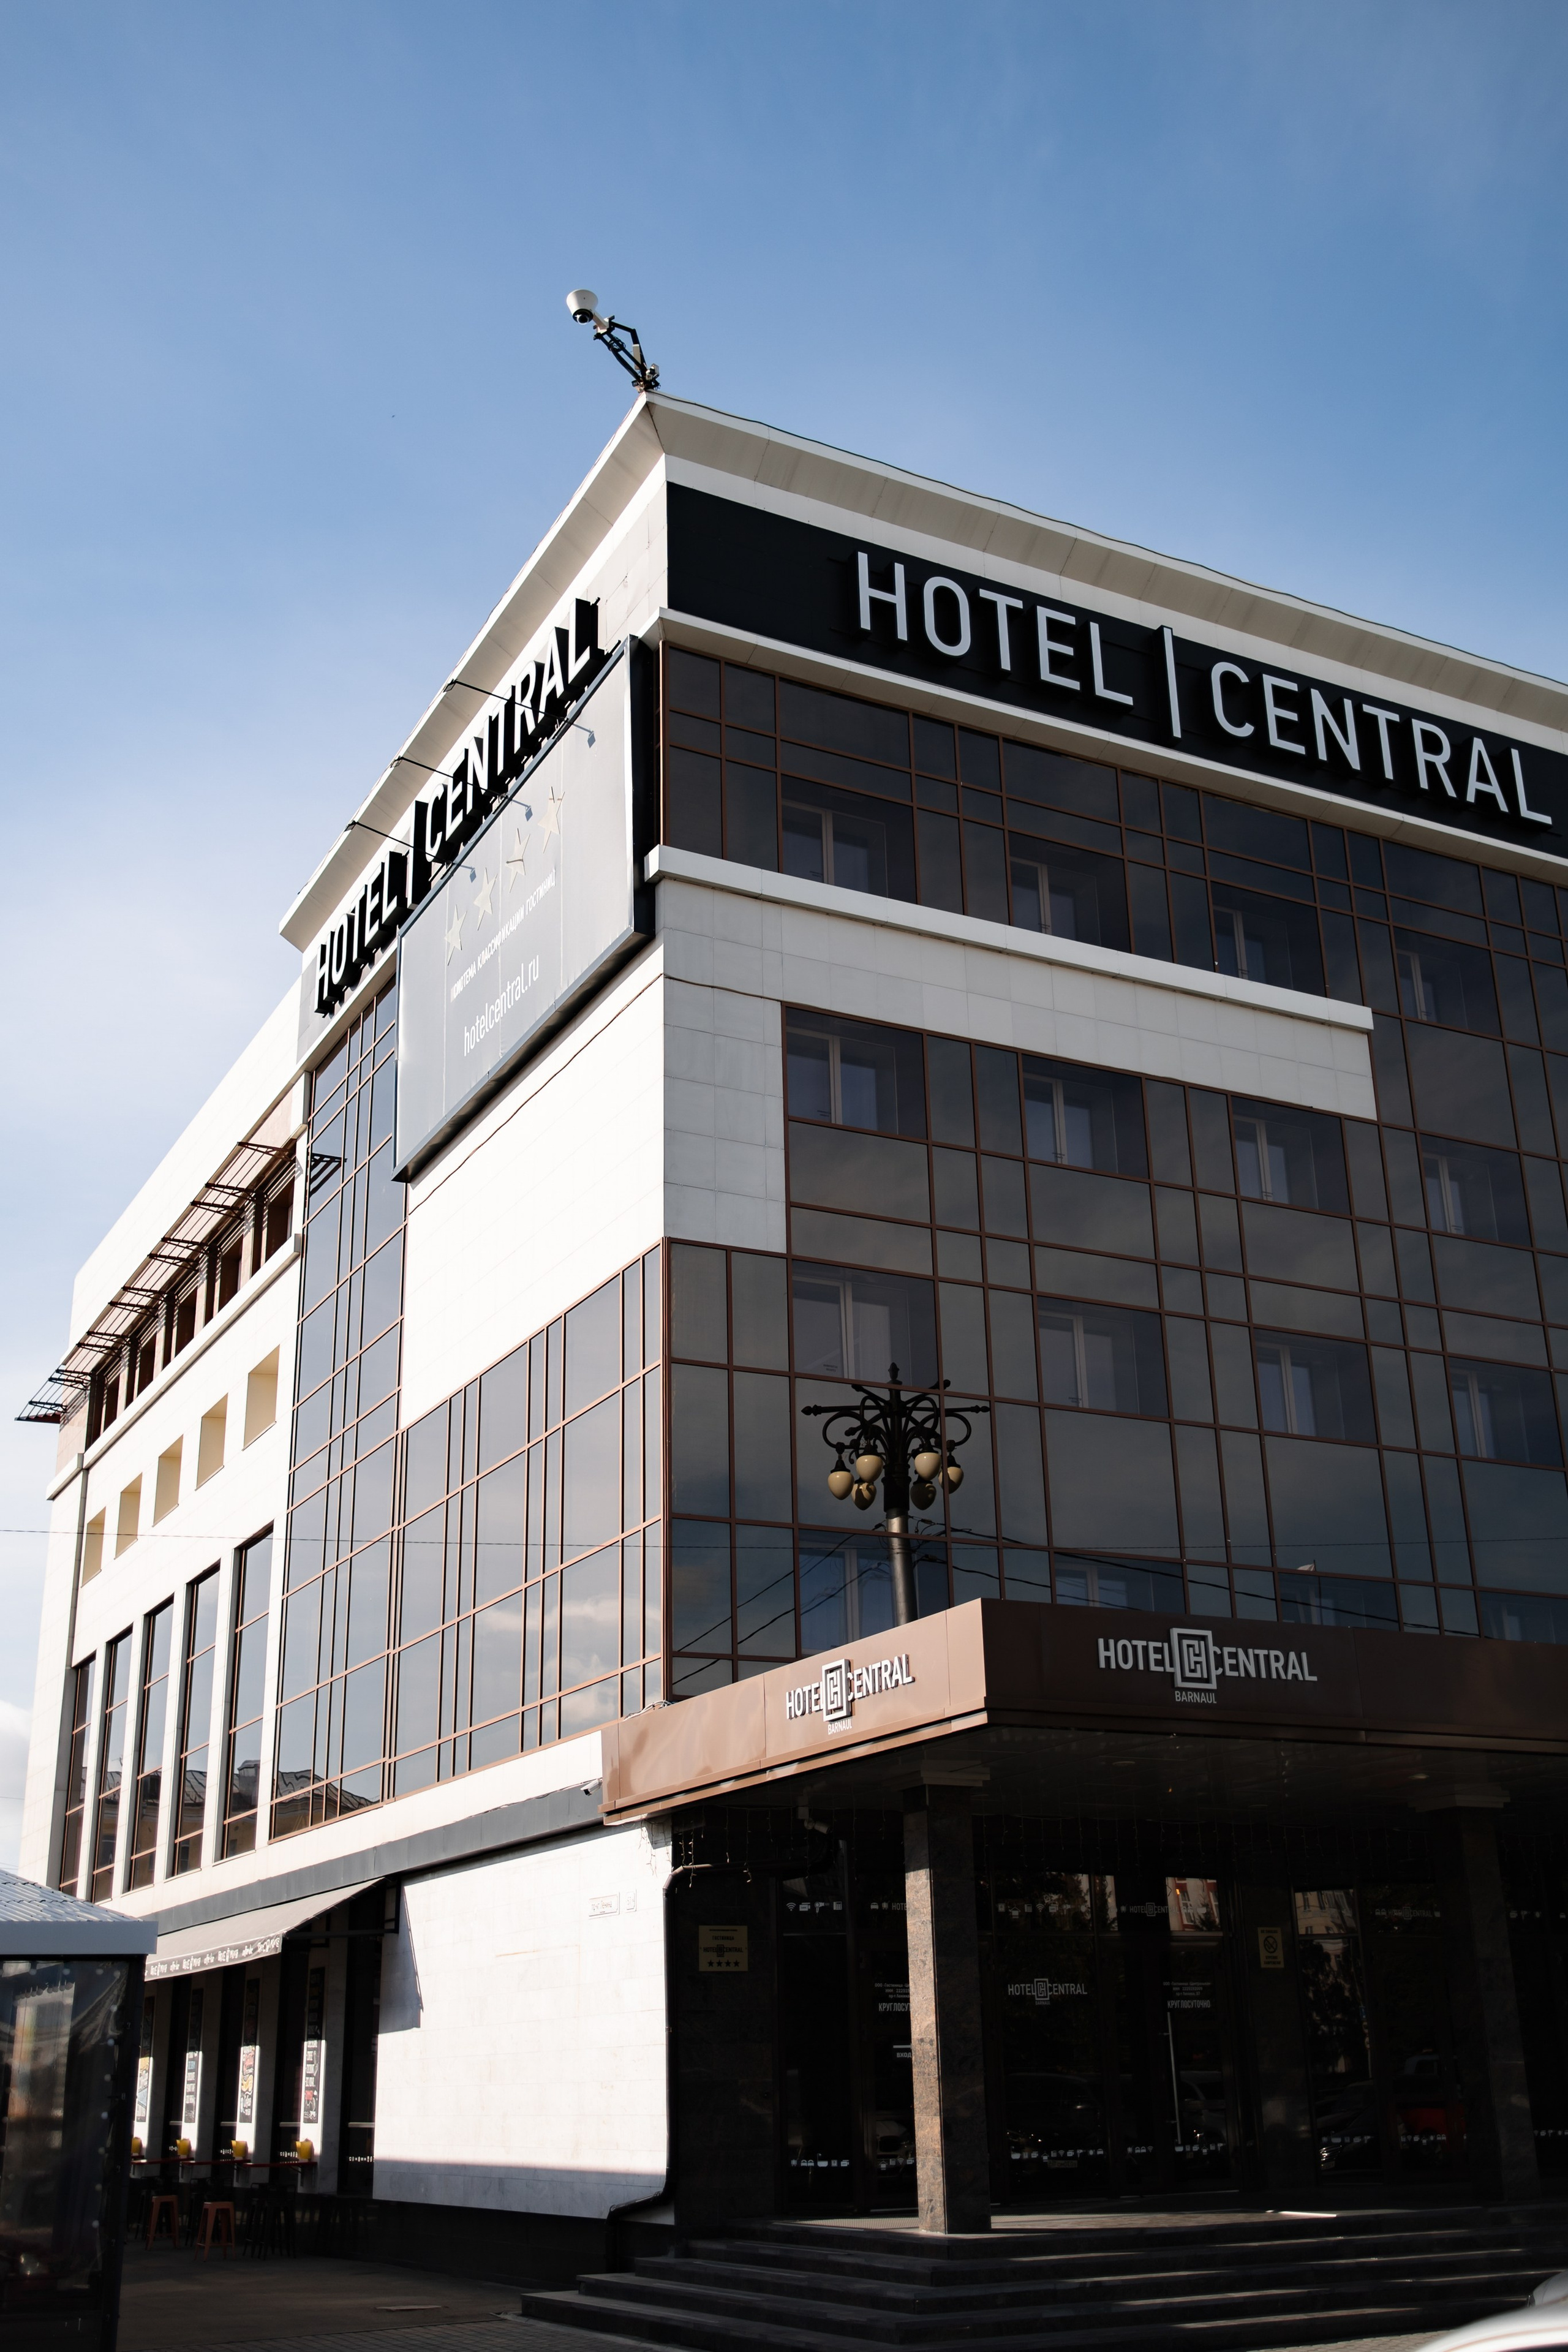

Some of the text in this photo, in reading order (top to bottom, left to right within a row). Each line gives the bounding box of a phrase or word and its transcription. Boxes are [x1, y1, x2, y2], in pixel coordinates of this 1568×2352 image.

[858, 551, 1553, 826] HOTEL CENTRAL
[315, 598, 595, 1014] HOTEL CENTRAL
[453, 868, 556, 998] СИСТЕМА КЛАССИФИКАЦИИ ГОСТИНИЦ
[464, 955, 539, 1057] hotelcentral.ru
[1098, 1637, 1174, 1673] HOTEL
[1212, 1645, 1317, 1681] CENTRAL
[786, 1681, 824, 1720] HOTEL
[1174, 1690, 1217, 1704] BARNAUL
[827, 1718, 853, 1735] BARNAUL
[892, 1902, 907, 1910] HOTE
[1008, 1984, 1035, 1996] HOTEL
[1048, 1983, 1088, 1995] CENTRAL
[878, 2002, 911, 2011] КРУГЛОСУТ
[1167, 2000, 1211, 2008] КРУГЛОСУТОЧНО
